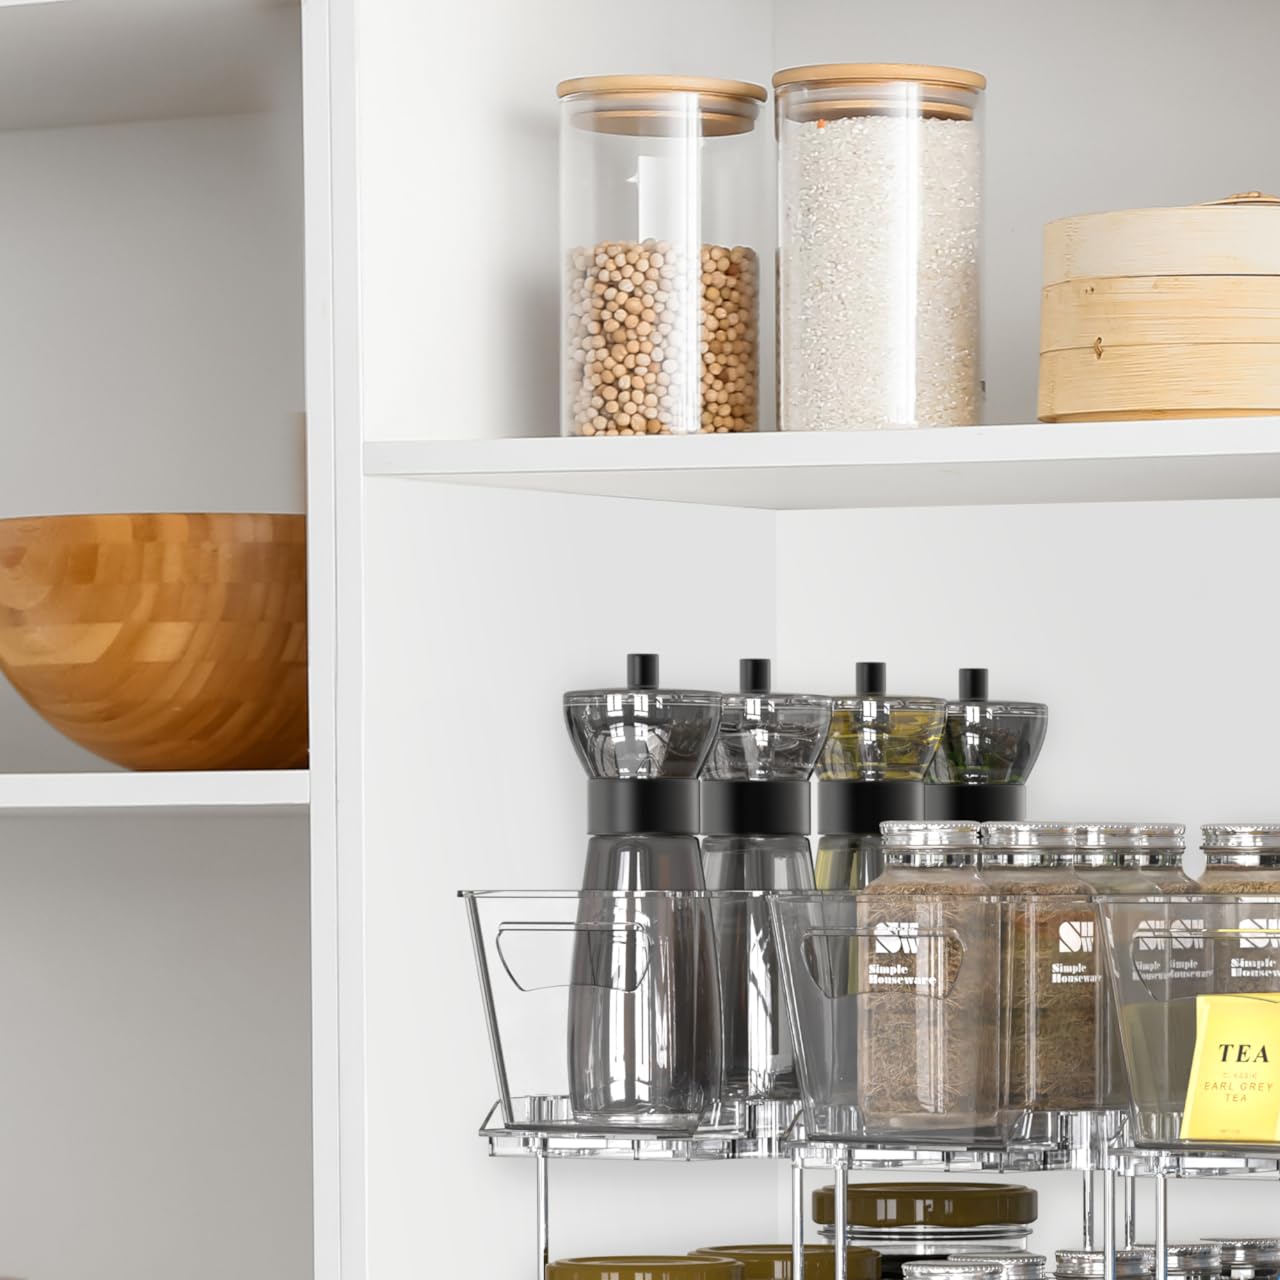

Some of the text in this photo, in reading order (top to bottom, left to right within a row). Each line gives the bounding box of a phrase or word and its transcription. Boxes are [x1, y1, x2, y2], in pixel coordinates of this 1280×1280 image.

[1051, 963, 1087, 975] Simple
[1230, 958, 1277, 969] Simple
[868, 964, 909, 976] Simple
[868, 974, 937, 985] Houseware
[1219, 1043, 1269, 1063] TEA
[1203, 1081, 1274, 1092] EARL GREY
[1225, 1093, 1248, 1103] TEA
